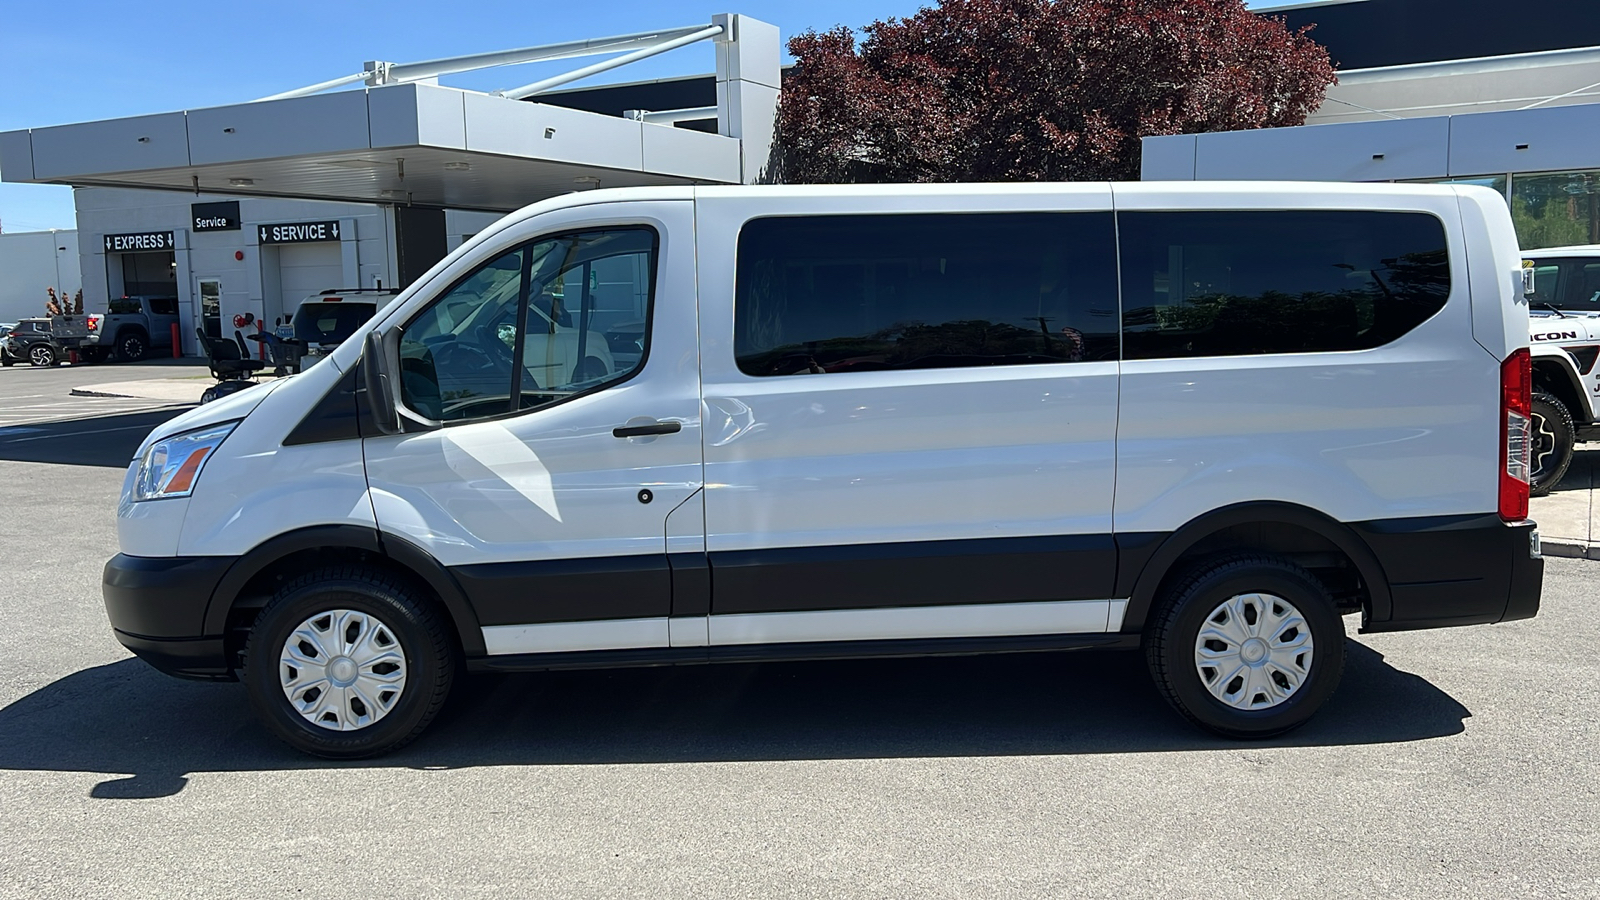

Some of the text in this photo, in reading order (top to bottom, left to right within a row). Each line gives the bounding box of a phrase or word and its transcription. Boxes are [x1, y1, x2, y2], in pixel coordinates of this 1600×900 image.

[196, 216, 227, 228] Service
[273, 224, 326, 241] SERVICE
[114, 234, 164, 250] EXPRESS
